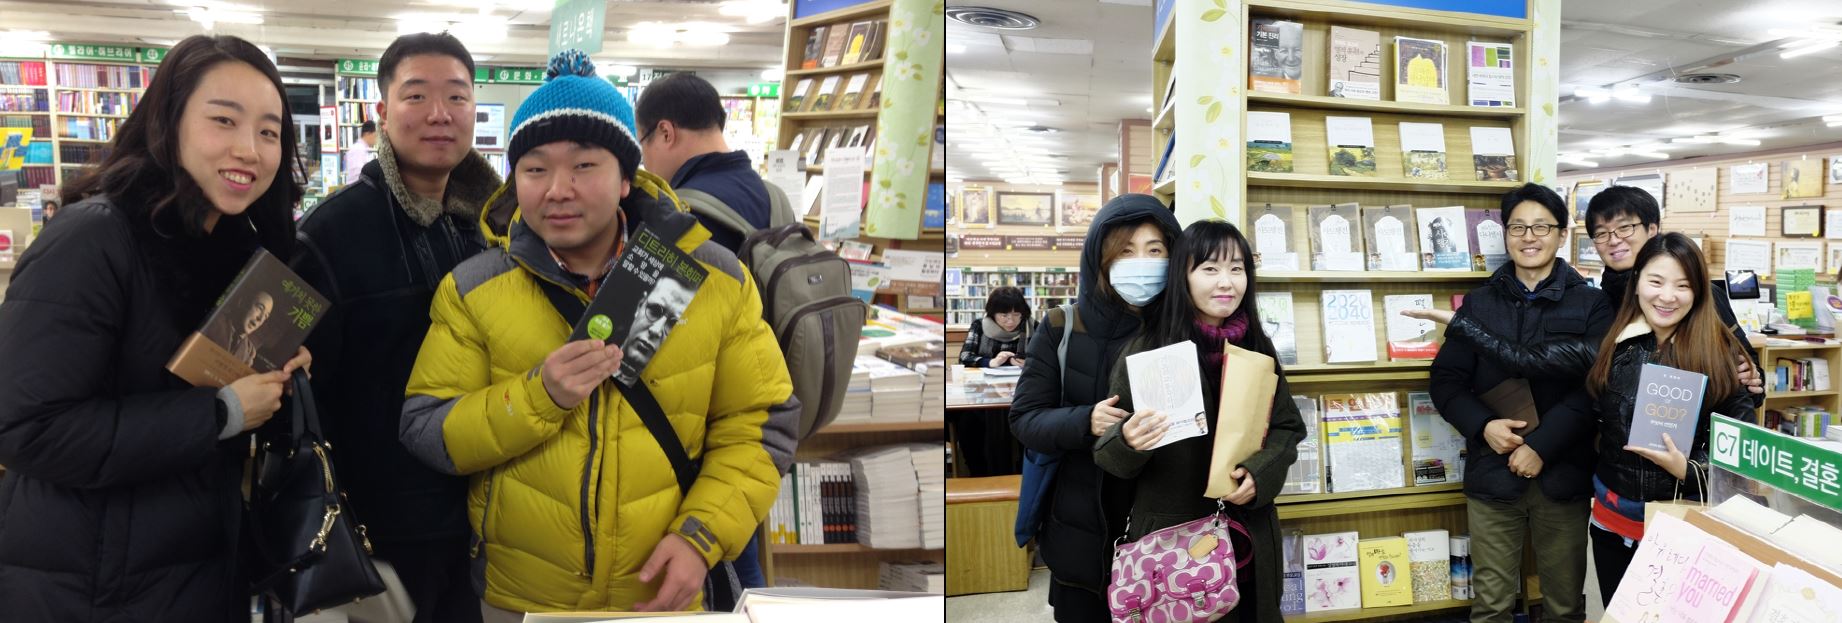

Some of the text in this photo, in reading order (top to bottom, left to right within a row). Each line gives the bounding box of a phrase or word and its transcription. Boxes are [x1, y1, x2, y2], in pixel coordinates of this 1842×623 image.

[639, 232, 704, 283] 디트리히 본회퍼
[288, 306, 315, 330] 기쁨
[1646, 383, 1692, 401] GOOD
[1645, 403, 1688, 421] GOD?
[1716, 432, 1737, 456] C7
[1676, 582, 1704, 608] you
[1686, 566, 1738, 608] married
